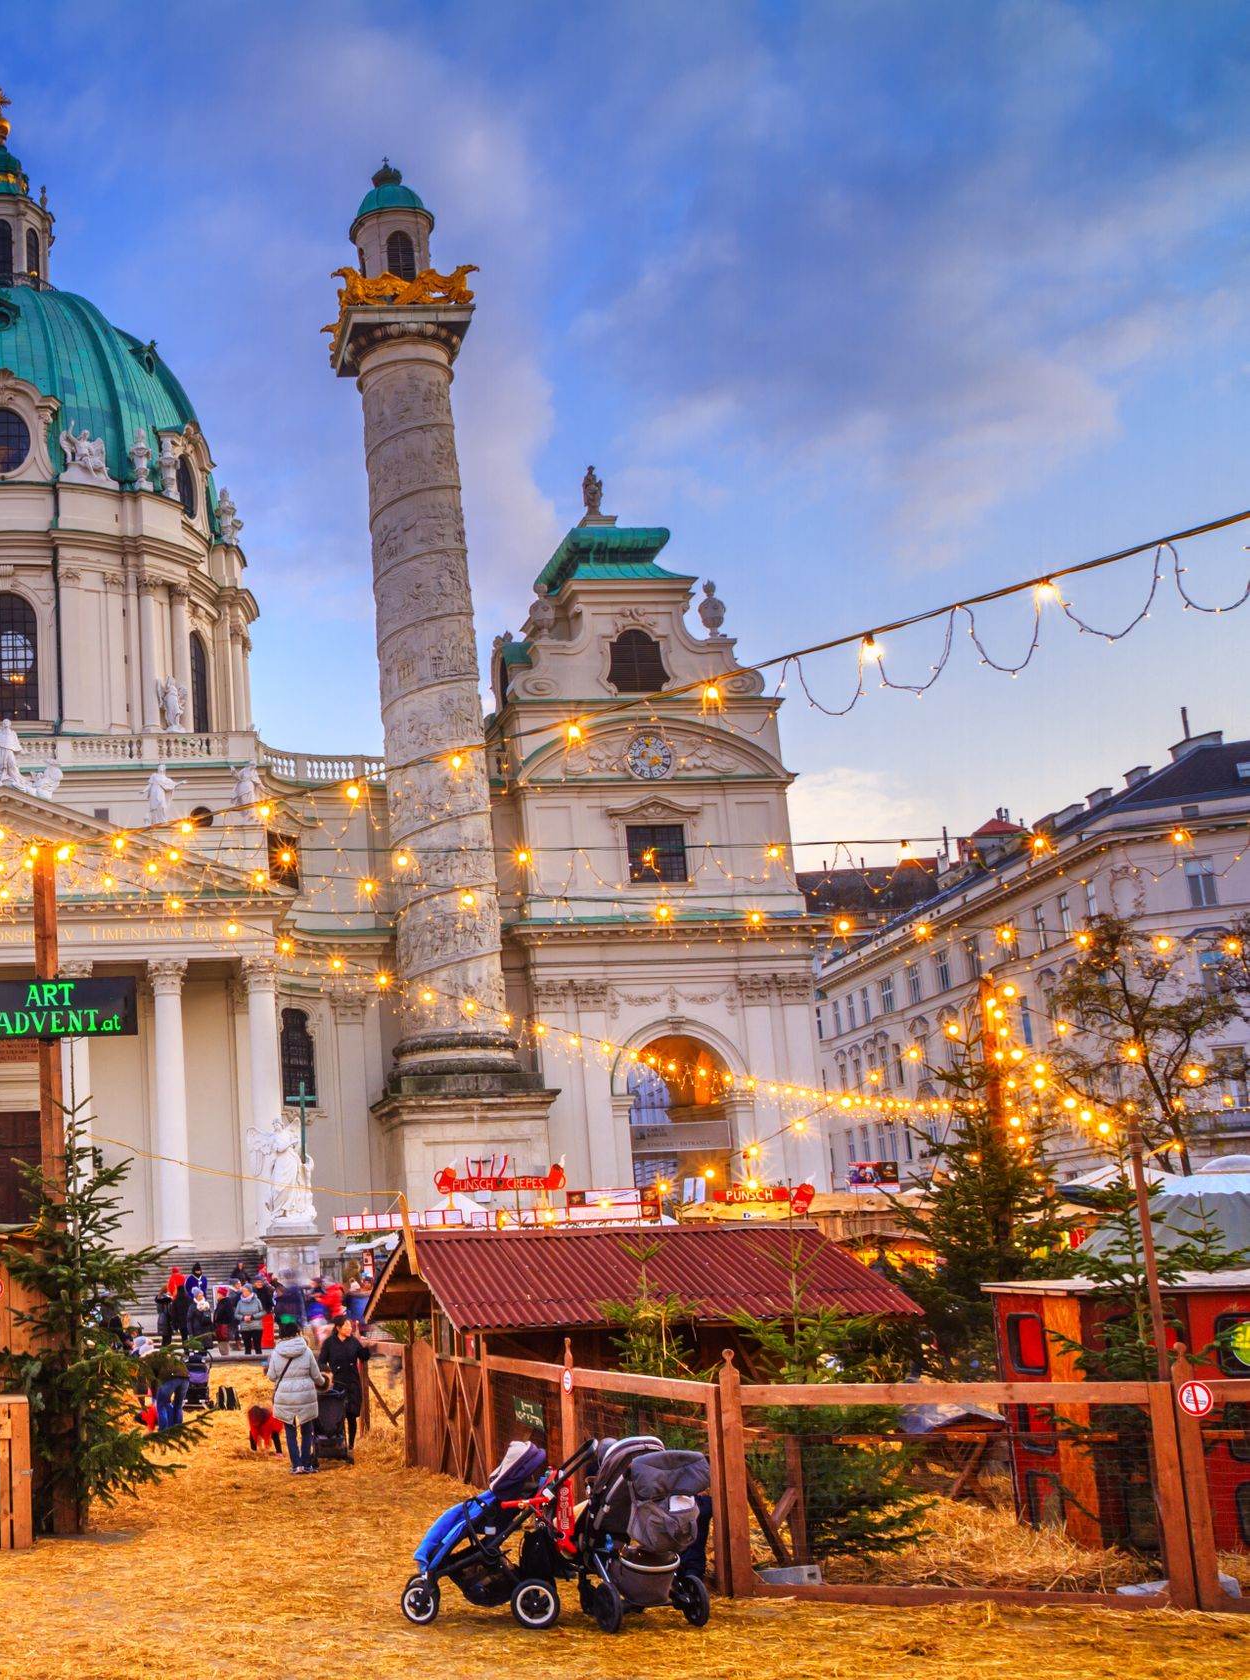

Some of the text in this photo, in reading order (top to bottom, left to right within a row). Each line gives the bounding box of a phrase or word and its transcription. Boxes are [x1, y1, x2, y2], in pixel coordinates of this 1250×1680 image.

[87, 925, 183, 941] TIMENTIVM
[25, 983, 75, 1007] ART
[452, 1178, 494, 1190] PUNSCH
[506, 1177, 545, 1189] CREPES
[726, 1190, 773, 1201] PUNSCH
